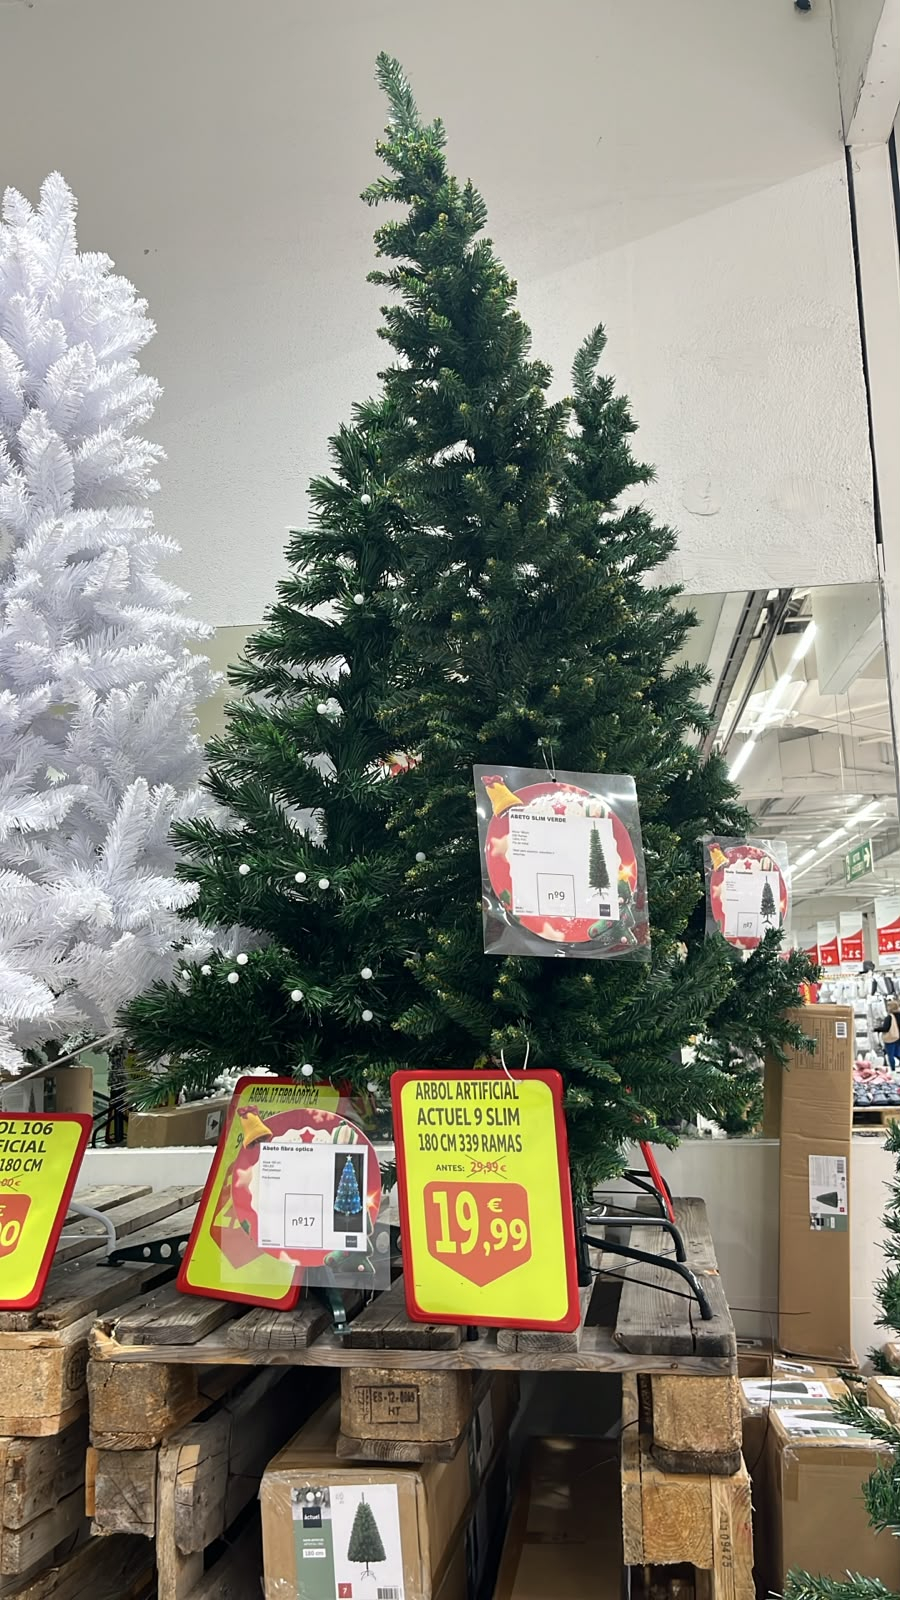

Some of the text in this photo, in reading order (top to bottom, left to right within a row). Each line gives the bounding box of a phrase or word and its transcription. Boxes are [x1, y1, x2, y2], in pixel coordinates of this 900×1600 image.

[547, 890, 566, 901] nº9
[415, 1081, 520, 1101] ARBOL ARTIFICIAL
[417, 1107, 521, 1126] ACTUEL 9 SLIM
[21, 1122, 54, 1136] 106
[262, 1145, 280, 1153] Abeto
[280, 1145, 294, 1153] fibra
[418, 1133, 523, 1153] 180 CM 339 RAMAS
[0, 1158, 44, 1172] 180 CM
[435, 1164, 466, 1173] ANTES:
[470, 1161, 499, 1175] 29,99
[291, 1216, 316, 1227] nº17
